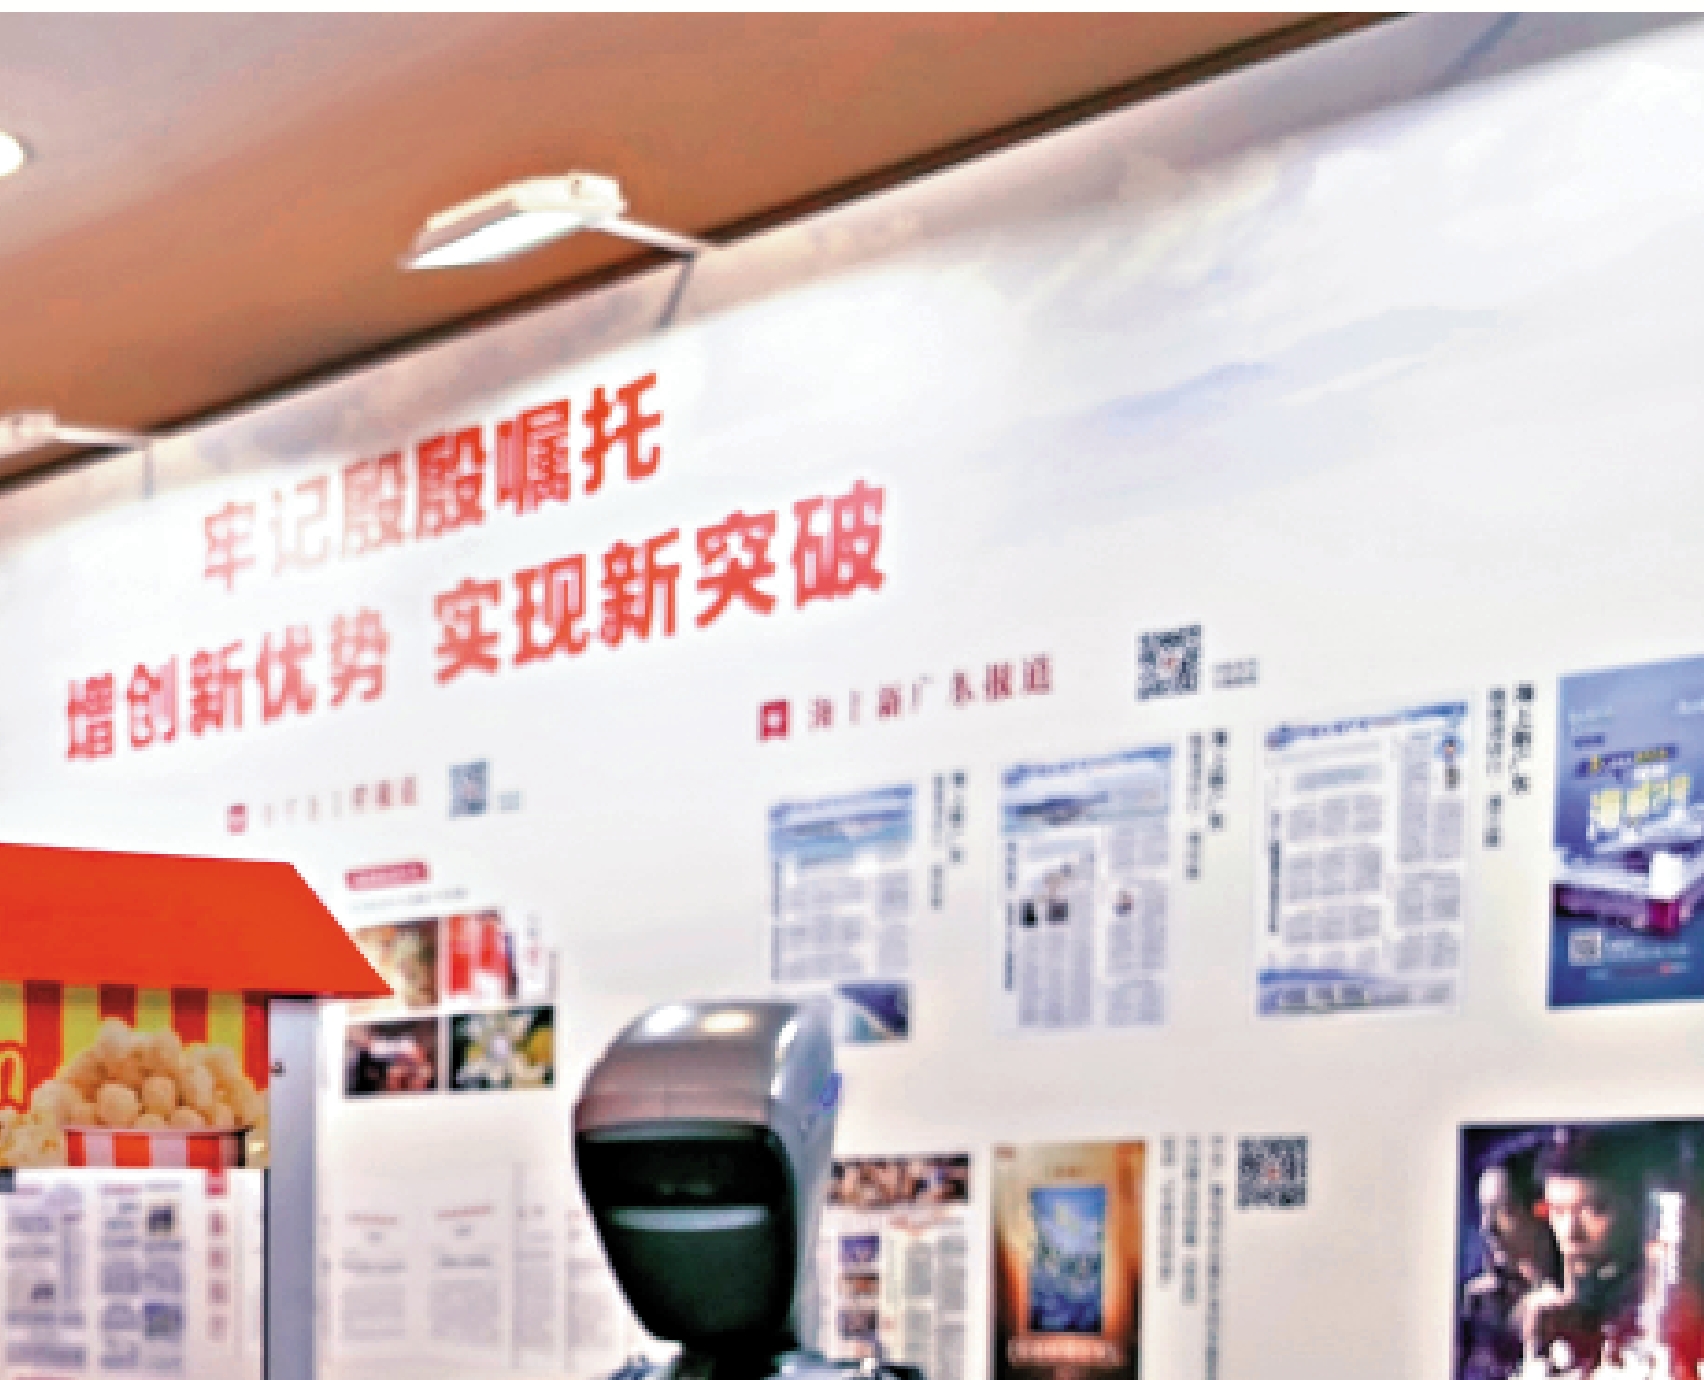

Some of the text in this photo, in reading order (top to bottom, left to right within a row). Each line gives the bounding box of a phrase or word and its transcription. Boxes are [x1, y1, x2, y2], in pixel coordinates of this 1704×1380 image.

[202, 370, 663, 594] 牢记殷殷嘱托
[65, 481, 885, 759] 增创新优势 实现新突破
